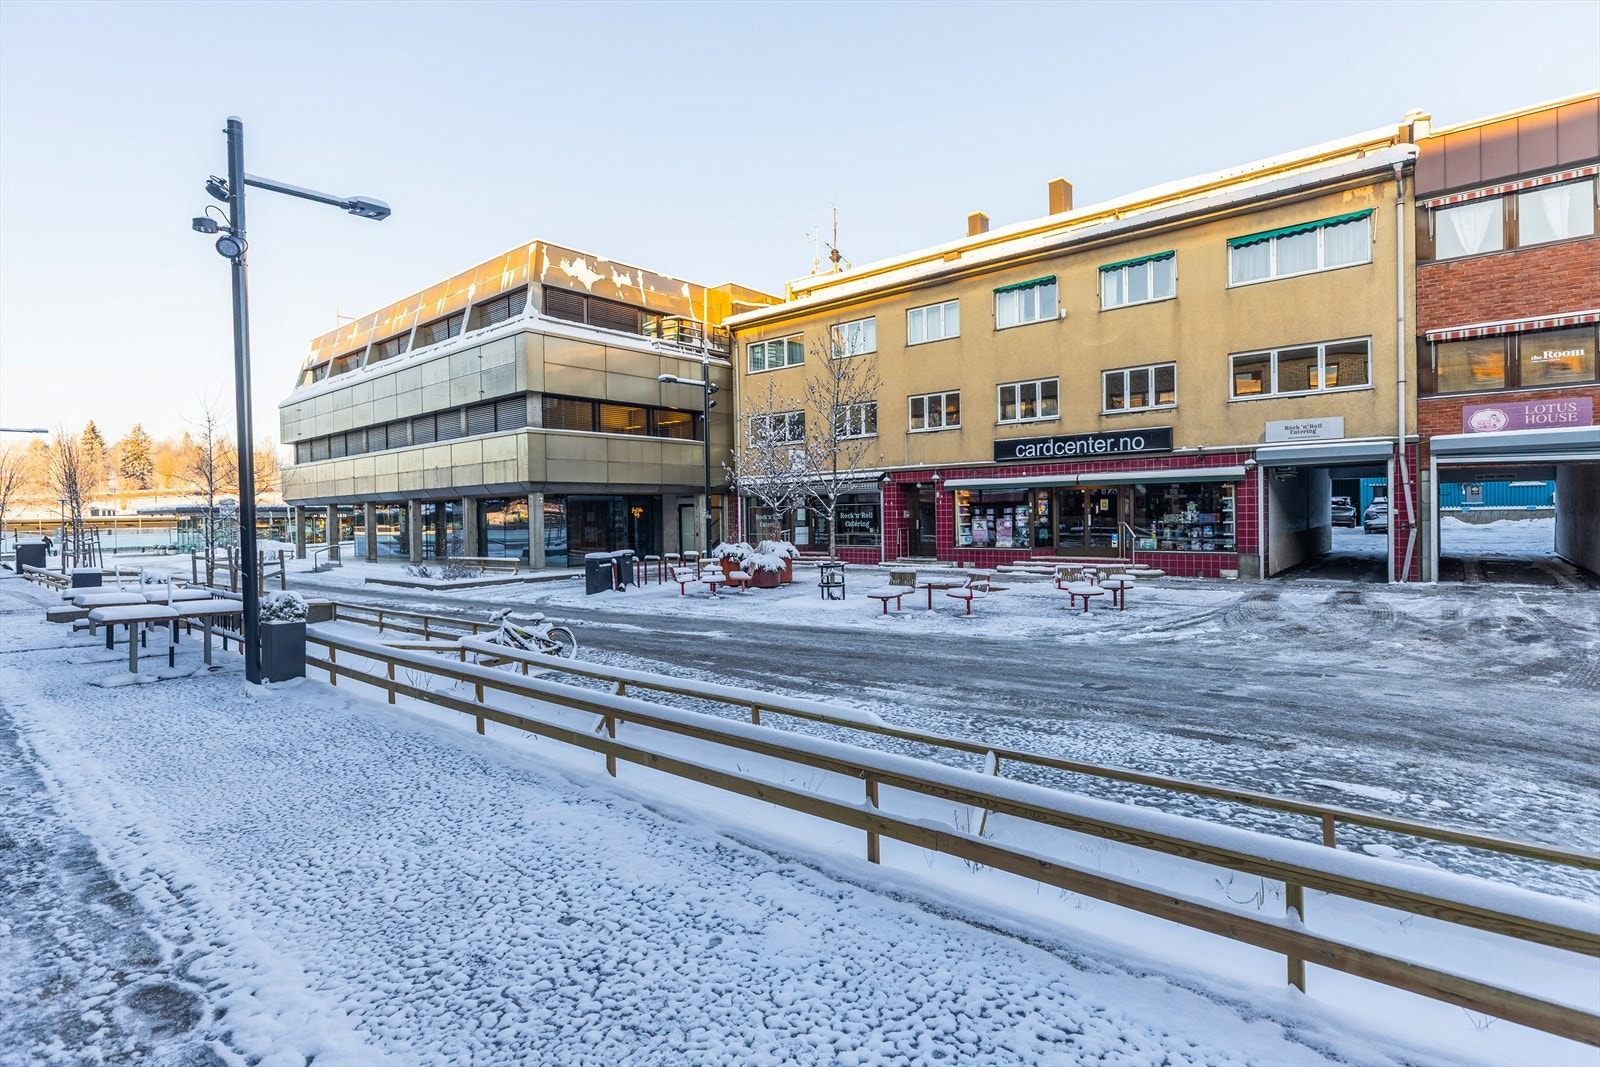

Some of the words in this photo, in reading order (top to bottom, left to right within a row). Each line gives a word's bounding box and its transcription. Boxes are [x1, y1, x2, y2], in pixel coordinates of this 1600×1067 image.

[1543, 348, 1585, 360] Room
[1525, 402, 1577, 415] LOTUS
[1525, 412, 1578, 424] HOUSE
[1015, 436, 1145, 457] cardcenter.no
[844, 520, 870, 528] Catering
